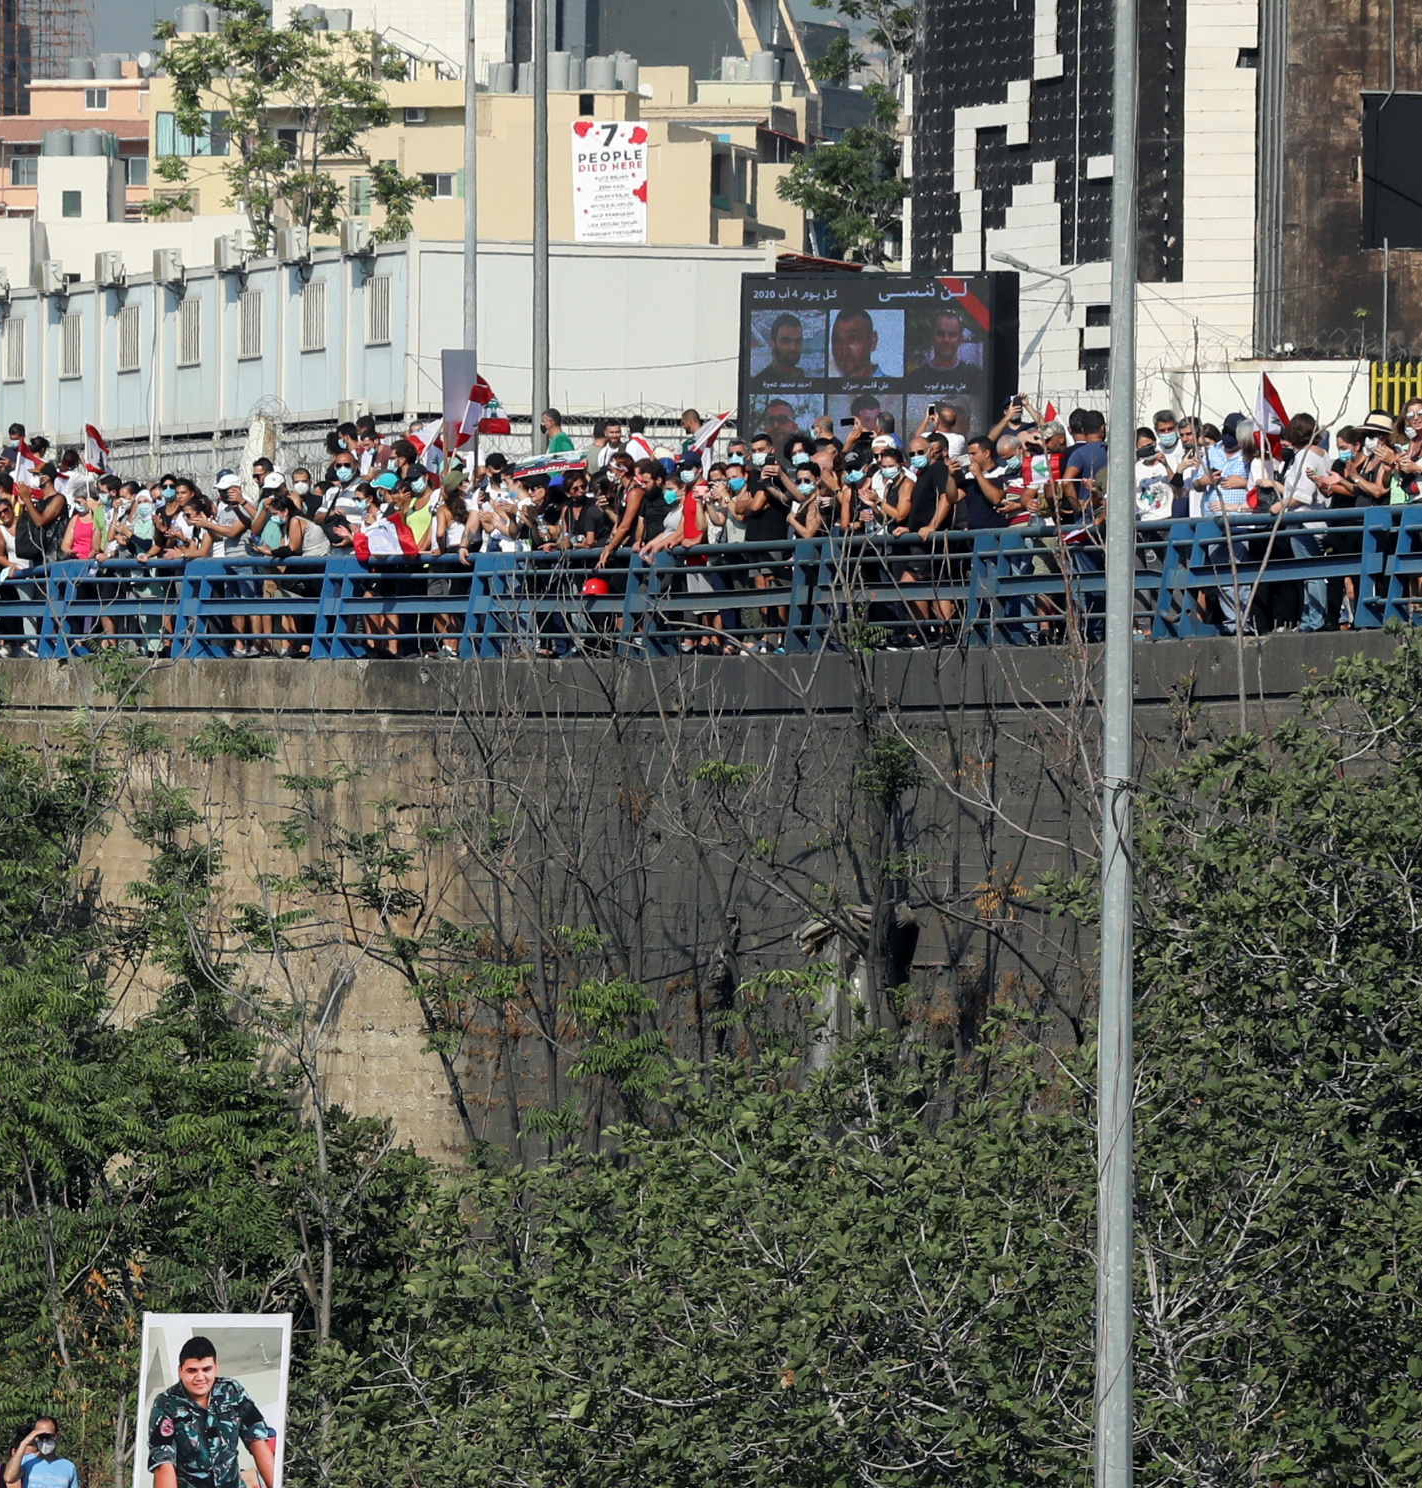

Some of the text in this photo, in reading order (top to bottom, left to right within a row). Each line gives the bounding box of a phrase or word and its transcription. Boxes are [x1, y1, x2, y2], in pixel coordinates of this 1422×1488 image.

[601, 123, 618, 147] 7
[578, 149, 643, 163] PEOPLE
[578, 161, 643, 172] DIED HERE
[753, 290, 776, 299] 2020
[792, 290, 798, 298] 4
[800, 290, 821, 301] يوم
[823, 289, 837, 300] كل
[878, 282, 968, 302] لن ننسى
